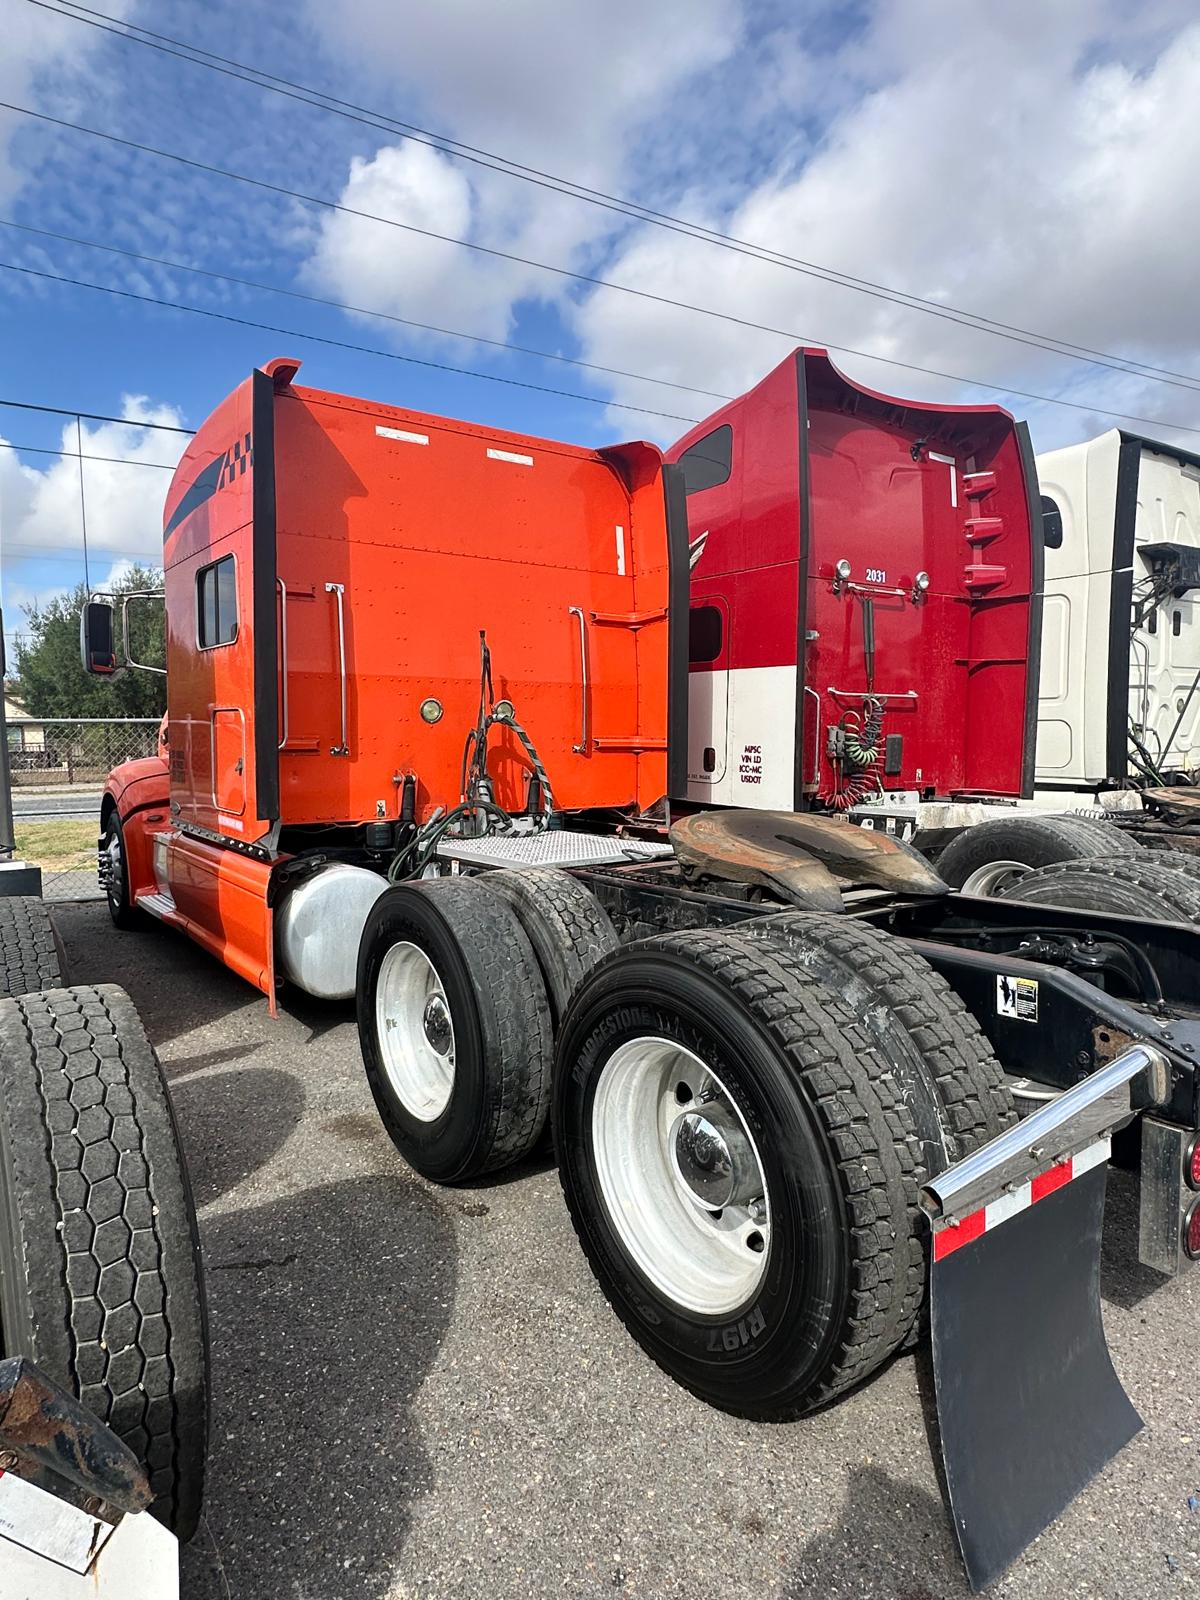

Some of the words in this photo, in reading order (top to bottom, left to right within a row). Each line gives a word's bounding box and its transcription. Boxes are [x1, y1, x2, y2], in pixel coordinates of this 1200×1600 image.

[865, 568, 886, 583] 2031
[741, 754, 752, 763] VIN
[740, 774, 762, 784] USDOT
